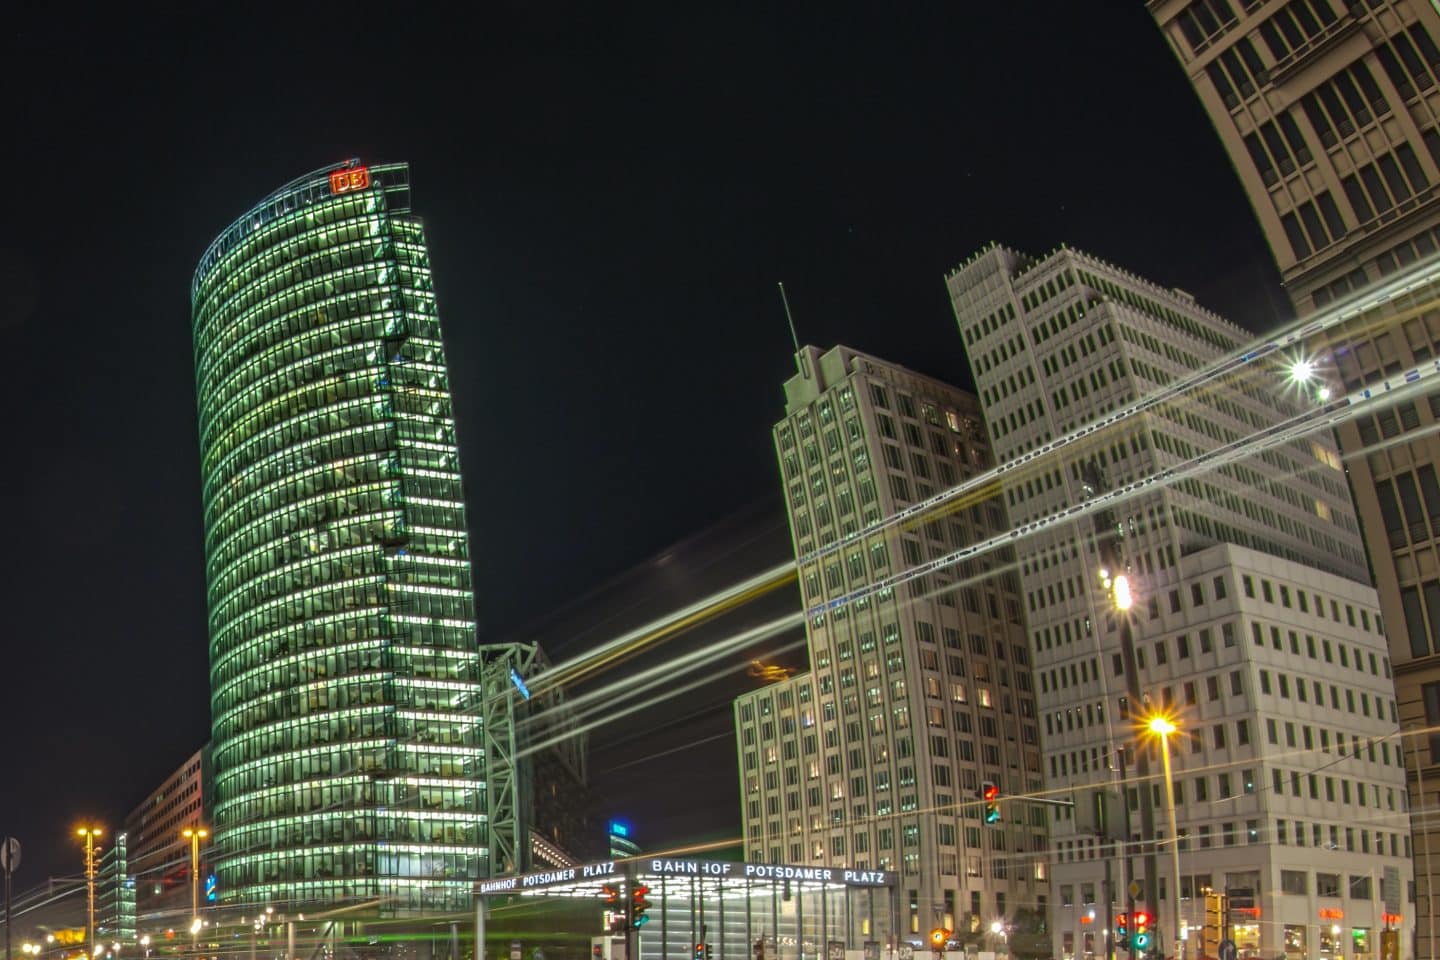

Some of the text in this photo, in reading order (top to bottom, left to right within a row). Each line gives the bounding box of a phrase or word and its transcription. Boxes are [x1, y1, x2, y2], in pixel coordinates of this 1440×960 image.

[332, 170, 366, 193] DB
[480, 862, 615, 893] BAHNHOF POTSDAMER PLATZ
[652, 860, 885, 883] BAHNHOF POTSDAMER PLATZ
